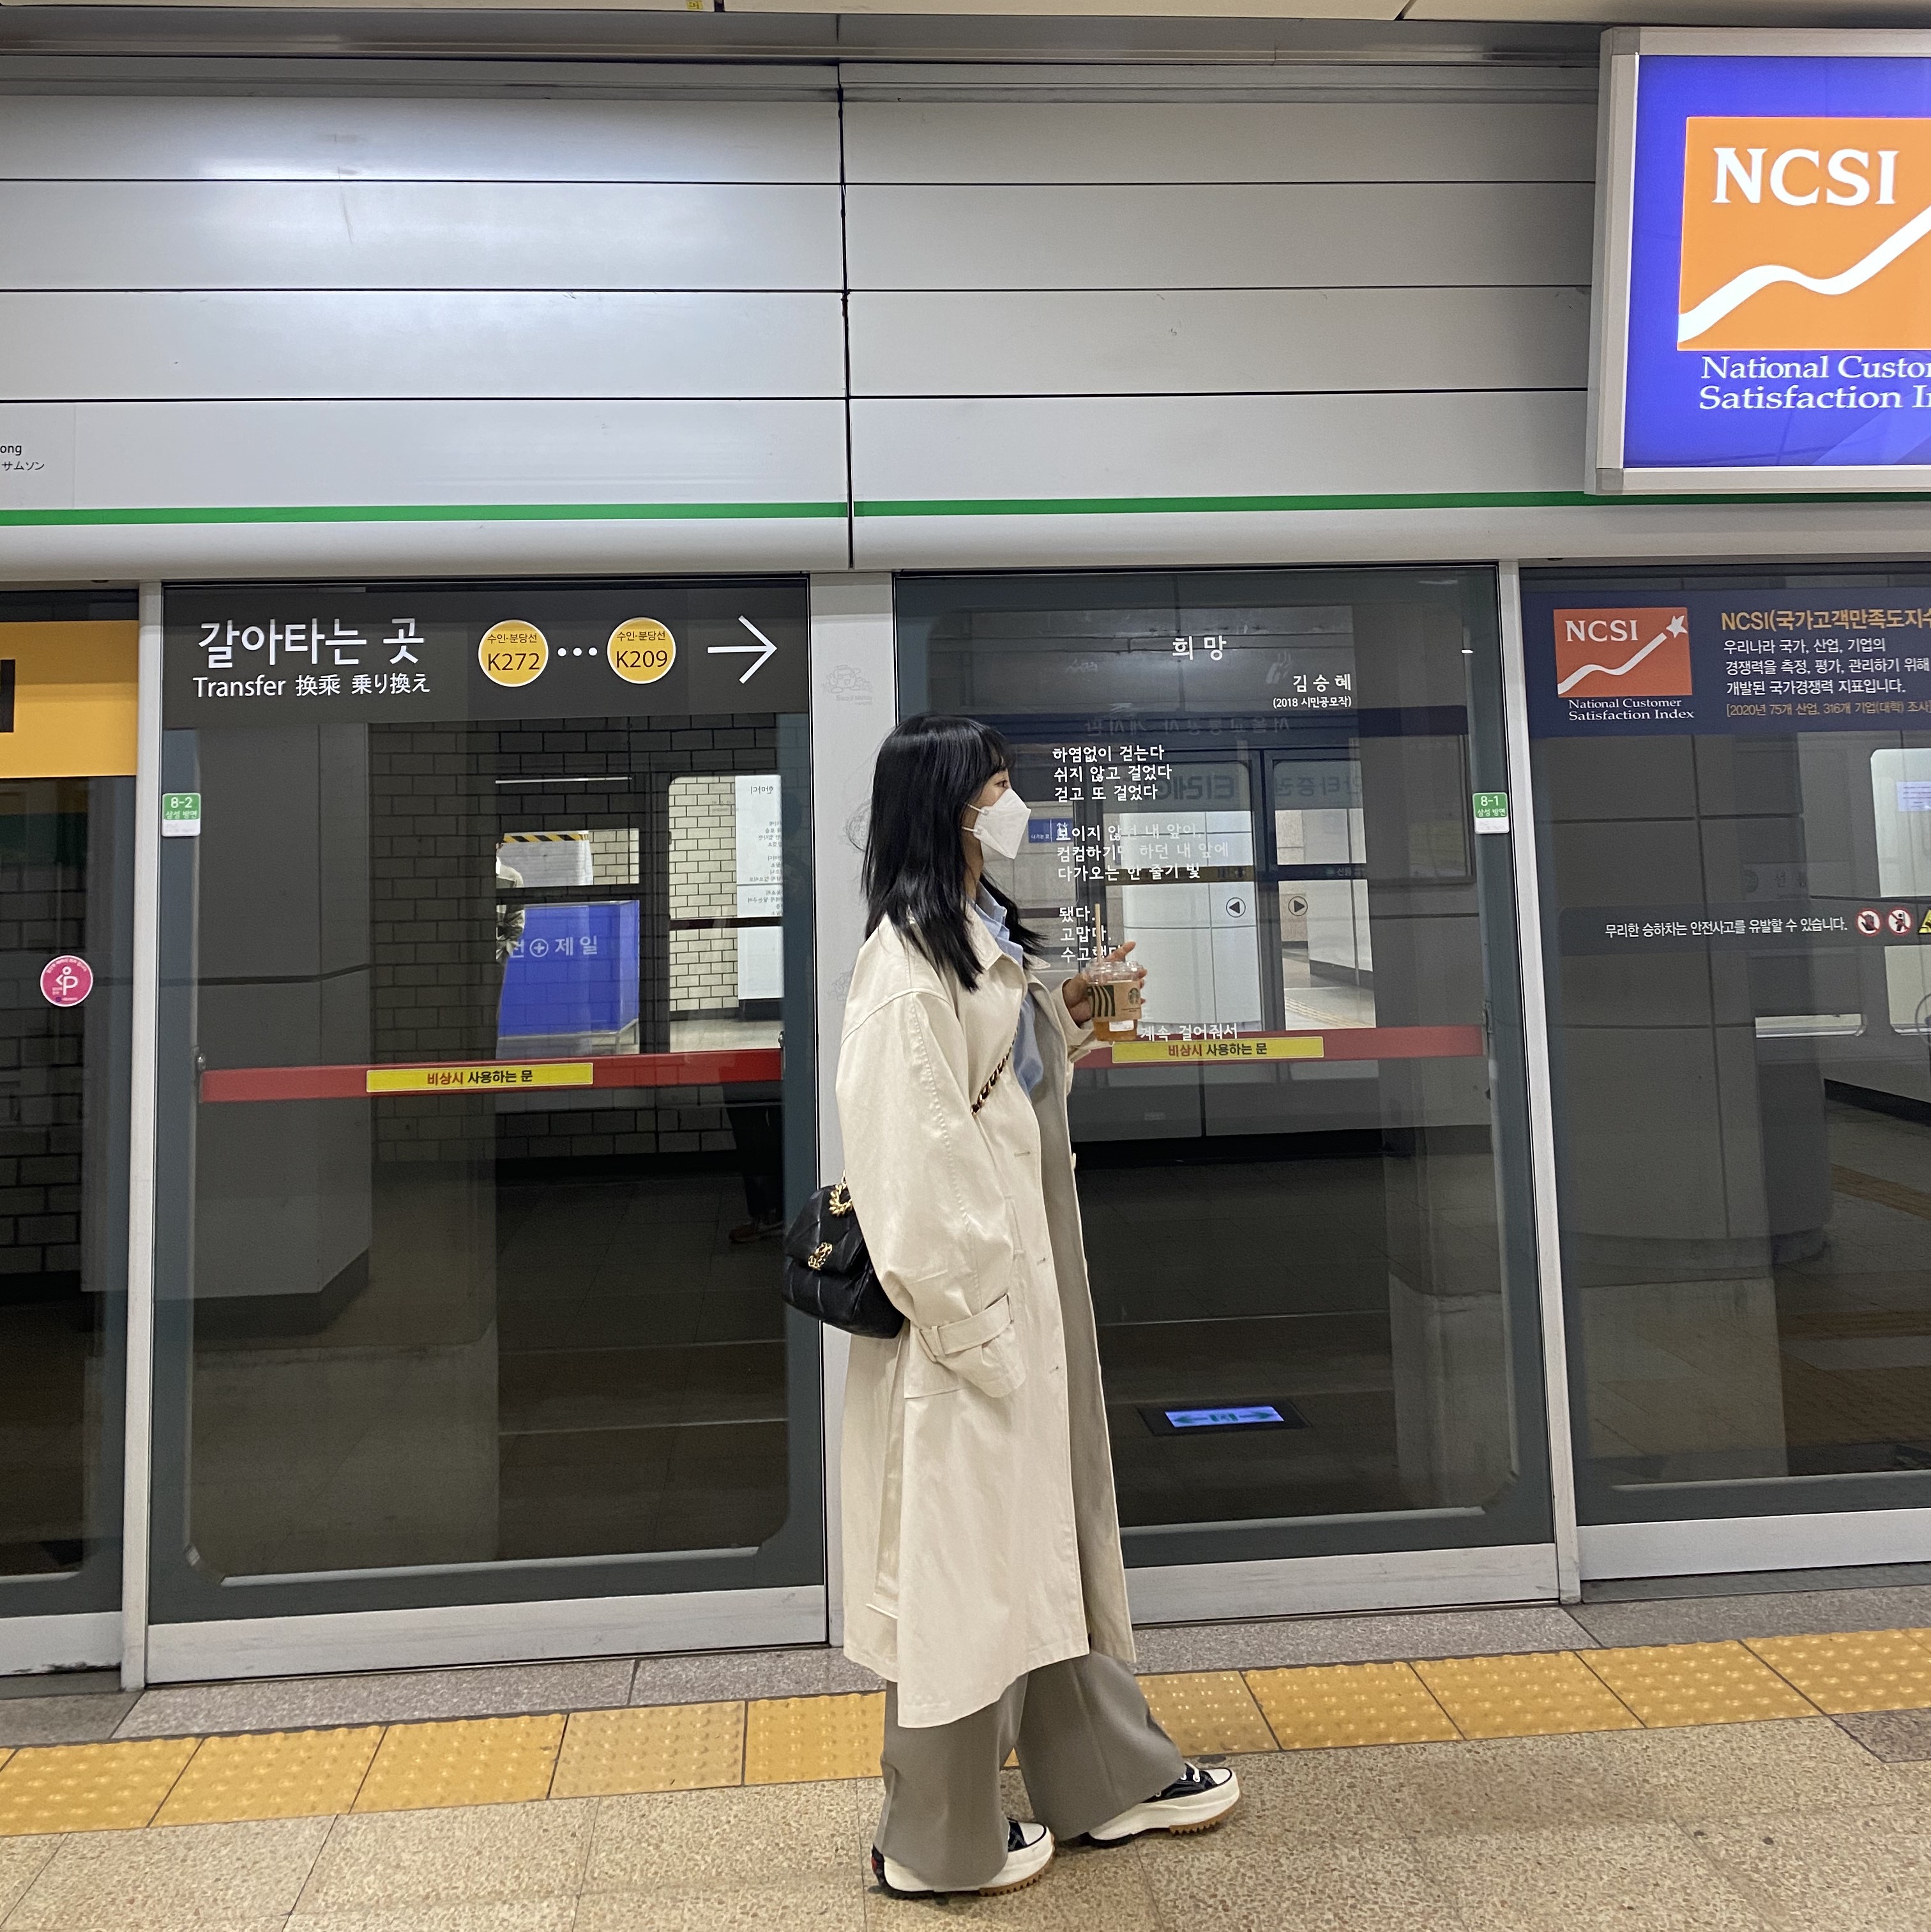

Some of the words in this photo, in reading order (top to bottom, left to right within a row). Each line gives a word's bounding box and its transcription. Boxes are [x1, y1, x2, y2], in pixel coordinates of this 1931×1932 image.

[1711, 147, 1900, 206] NCSI
[1700, 355, 1829, 379] National
[1699, 384, 1904, 410] Satisfaction
[1, 461, 45, 471] サムソン
[1565, 620, 1639, 642] NCSI
[199, 618, 367, 669] 갈아타는
[382, 618, 424, 665] 곳
[1723, 639, 1775, 655] 우리나라
[1778, 639, 1809, 655] 국가,
[1814, 638, 1843, 654] 산업,
[1847, 637, 1886, 652] 기업의
[487, 652, 541, 671] K272
[616, 650, 668, 669] K209
[1725, 659, 1777, 676] 경쟁력을
[1780, 658, 1811, 675] 측정,
[1815, 658, 1845, 674] 평가,
[1848, 657, 1900, 673] 관리하기
[1904, 657, 1931, 672] 위해
[192, 674, 286, 697] Transfer
[351, 672, 430, 696] 乗り換え
[1727, 680, 1766, 696] 개발된
[1769, 679, 1833, 696] 국가경쟁력
[1838, 678, 1906, 694] 지표입니다.
[1273, 697, 1298, 709] (2018
[1300, 696, 1352, 709] 시민공모작)
[1568, 698, 1621, 709] National
[1623, 697, 1682, 708] Customer
[1568, 710, 1651, 722] Satisfaction
[1654, 709, 1695, 720] Index
[1052, 745, 1112, 764] 하염없이
[1119, 743, 1165, 763] 걷는다
[1053, 766, 1084, 783] 쉬지
[1090, 765, 1121, 782] 않고
[1128, 763, 1172, 782] 걸었다
[170, 796, 193, 809] 8-2
[1054, 785, 1085, 803] 걷고
[1091, 786, 1108, 801] 또
[1113, 783, 1158, 802] 걸었다
[1480, 795, 1499, 807] 8-1
[1477, 808, 1490, 818] 삼성
[1057, 864, 1120, 882] 다가오는
[1127, 864, 1142, 880] 한
[1149, 863, 1178, 880] 줄기
[1186, 862, 1200, 879] 빛
[1059, 905, 1095, 923] 됐다.
[1604, 922, 1639, 938] 무리한
[1642, 922, 1688, 938] 승하차는
[1690, 920, 1746, 936] 안전사고를
[1748, 918, 1783, 934] 유발할
[1785, 918, 1798, 933] 수
[1800, 917, 1848, 932] 있습니다.
[1140, 1024, 1171, 1042] 계속
[1178, 1023, 1238, 1041] 걸어줘서
[1167, 1043, 1203, 1058] 비상시
[1206, 1042, 1253, 1057] 사용하는
[1255, 1042, 1268, 1056] 문
[427, 1071, 464, 1086] 비상시
[467, 1069, 517, 1084] 사용하는
[520, 1069, 533, 1083] 문
